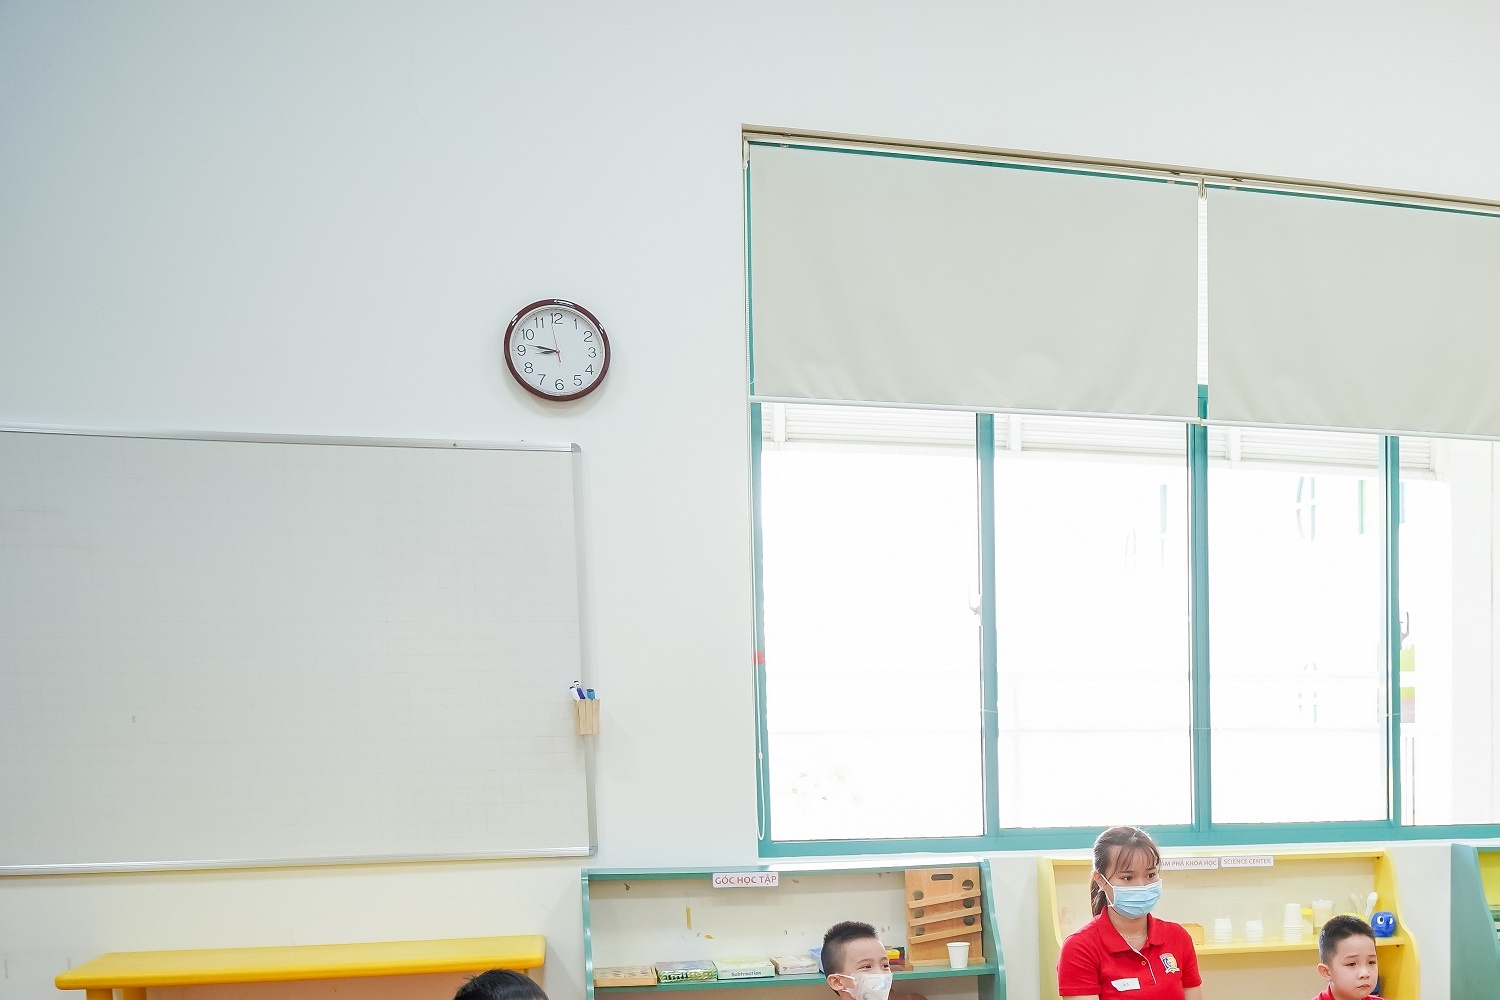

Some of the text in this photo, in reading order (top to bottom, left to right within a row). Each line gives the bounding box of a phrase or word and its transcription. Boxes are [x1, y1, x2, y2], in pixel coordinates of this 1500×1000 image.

[534, 317, 545, 329] 11
[550, 312, 563, 325] 12
[573, 318, 578, 330] 1
[521, 328, 535, 341] 10
[583, 331, 593, 342] 2
[517, 344, 527, 357] 9
[587, 346, 597, 358] 3
[524, 361, 534, 374] 8
[585, 364, 594, 375] 4
[537, 373, 546, 385] 7
[554, 378, 565, 391] 6
[573, 374, 583, 386] 5
[715, 874, 777, 886] GÓC HỌC TẬP
